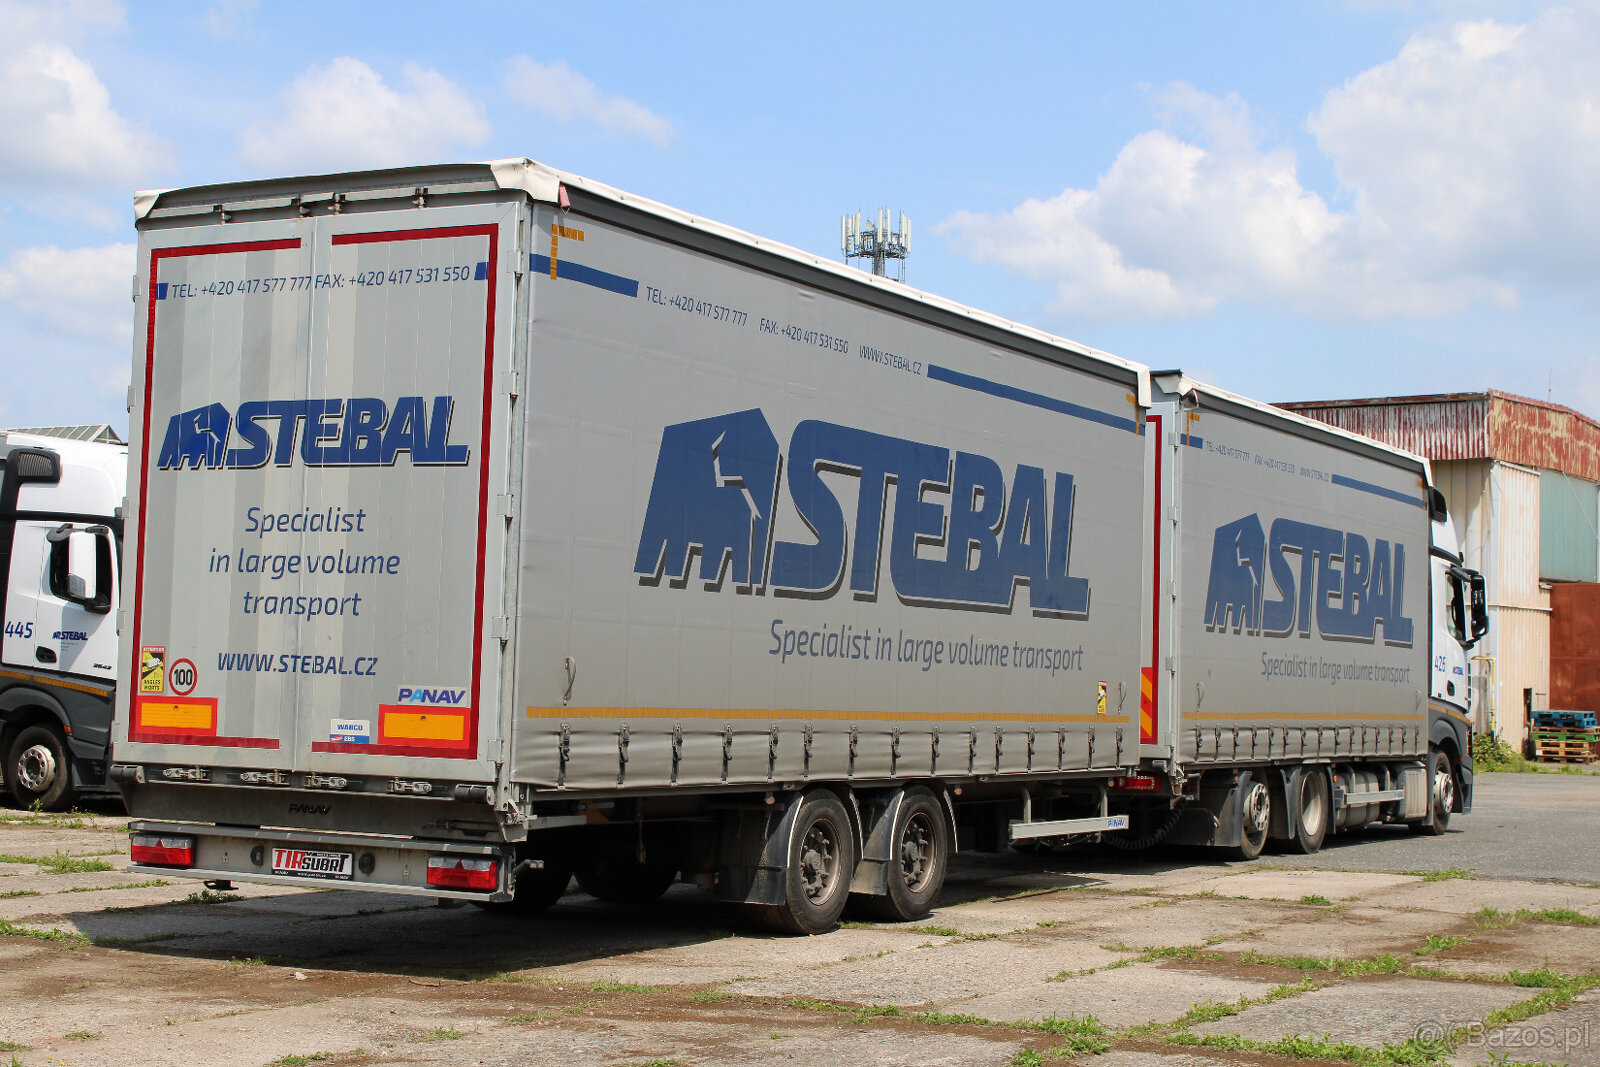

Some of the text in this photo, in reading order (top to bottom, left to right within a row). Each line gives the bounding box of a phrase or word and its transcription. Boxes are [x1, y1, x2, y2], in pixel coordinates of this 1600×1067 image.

[172, 275, 312, 299] TEL: +420 417 577 777
[314, 265, 470, 289] FAX: +420 417 531 550
[646, 286, 748, 327] TEL: +420 417 577 777
[759, 317, 849, 354] FAX: +420 417 531 550
[859, 344, 922, 375] WWW.STEBAL.CZ
[226, 396, 470, 468] STEBAL
[245, 506, 367, 538] Specialist
[770, 419, 1090, 621] STEBAL
[209, 548, 400, 580] in large volume
[1262, 517, 1413, 649] STEBAL
[243, 590, 362, 621] transport
[4, 621, 34, 639] 445
[768, 619, 1085, 678] Specialist in large volume transport
[174, 668, 194, 686] 100
[217, 652, 379, 677] WWW.STEBAL.CZ
[1261, 651, 1411, 687] Specialist in large volume transport
[397, 688, 466, 705] PANAV
[274, 849, 306, 870] TIR
